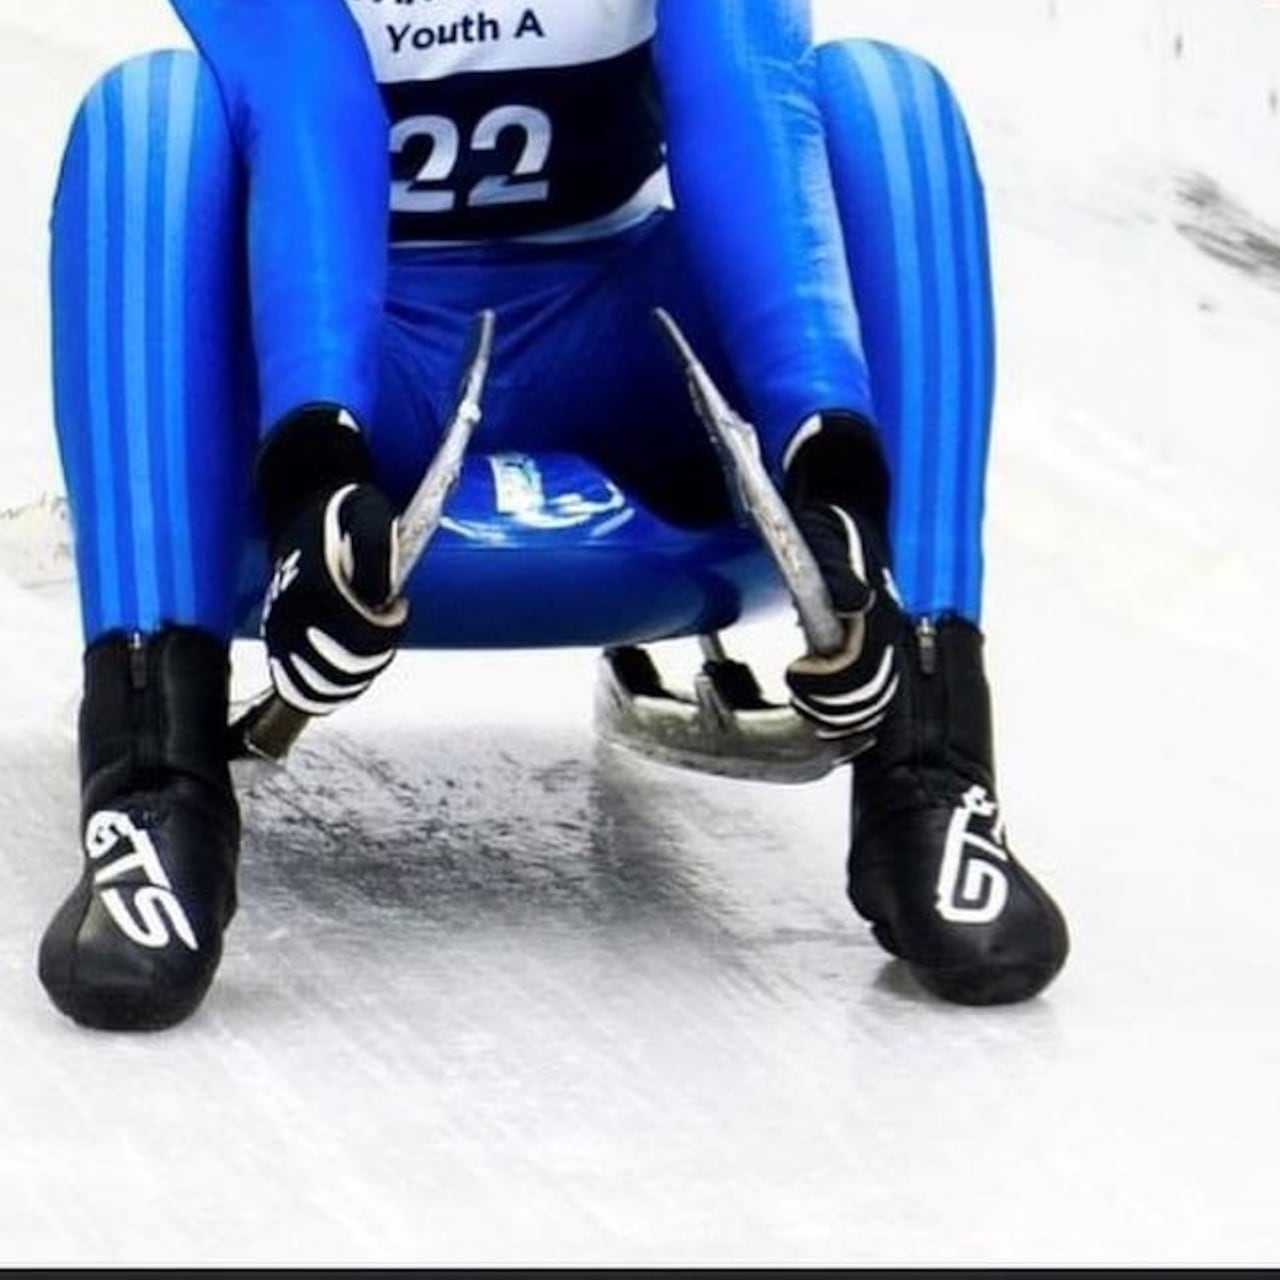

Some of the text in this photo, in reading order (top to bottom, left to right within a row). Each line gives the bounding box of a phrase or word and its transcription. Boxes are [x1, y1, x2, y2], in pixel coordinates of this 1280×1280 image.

[386, 9, 546, 53] Youth A
[390, 105, 551, 212] 22
[86, 810, 198, 951] GTS
